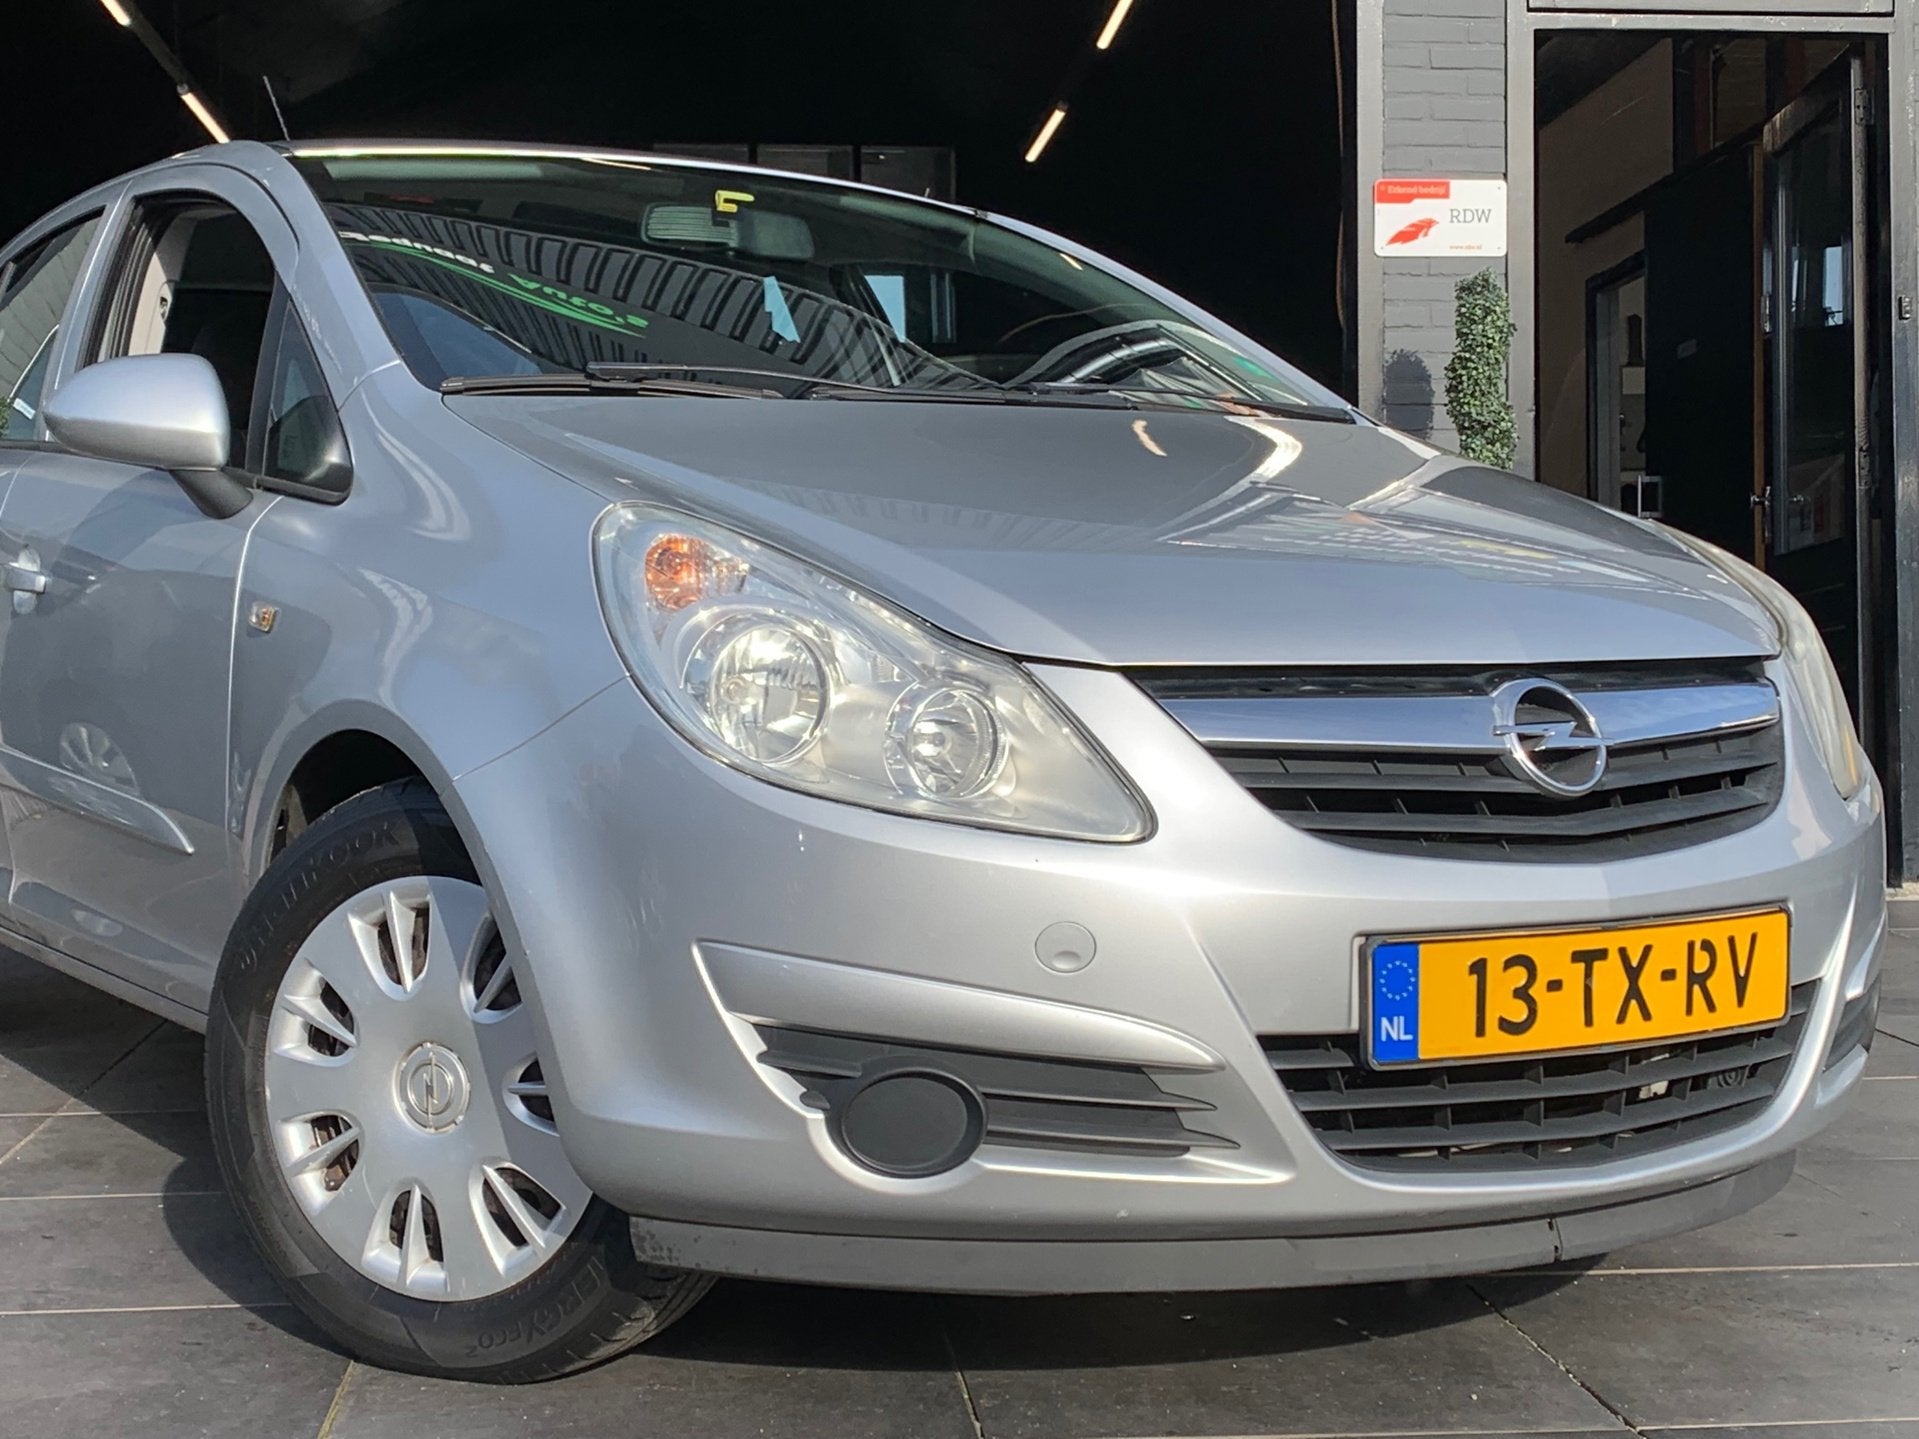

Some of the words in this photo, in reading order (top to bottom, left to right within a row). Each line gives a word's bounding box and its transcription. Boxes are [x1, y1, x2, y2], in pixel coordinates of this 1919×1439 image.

[1449, 208, 1492, 224] RDW
[1468, 931, 1758, 1038] 13-TX-RV
[1380, 1015, 1413, 1042] NL
